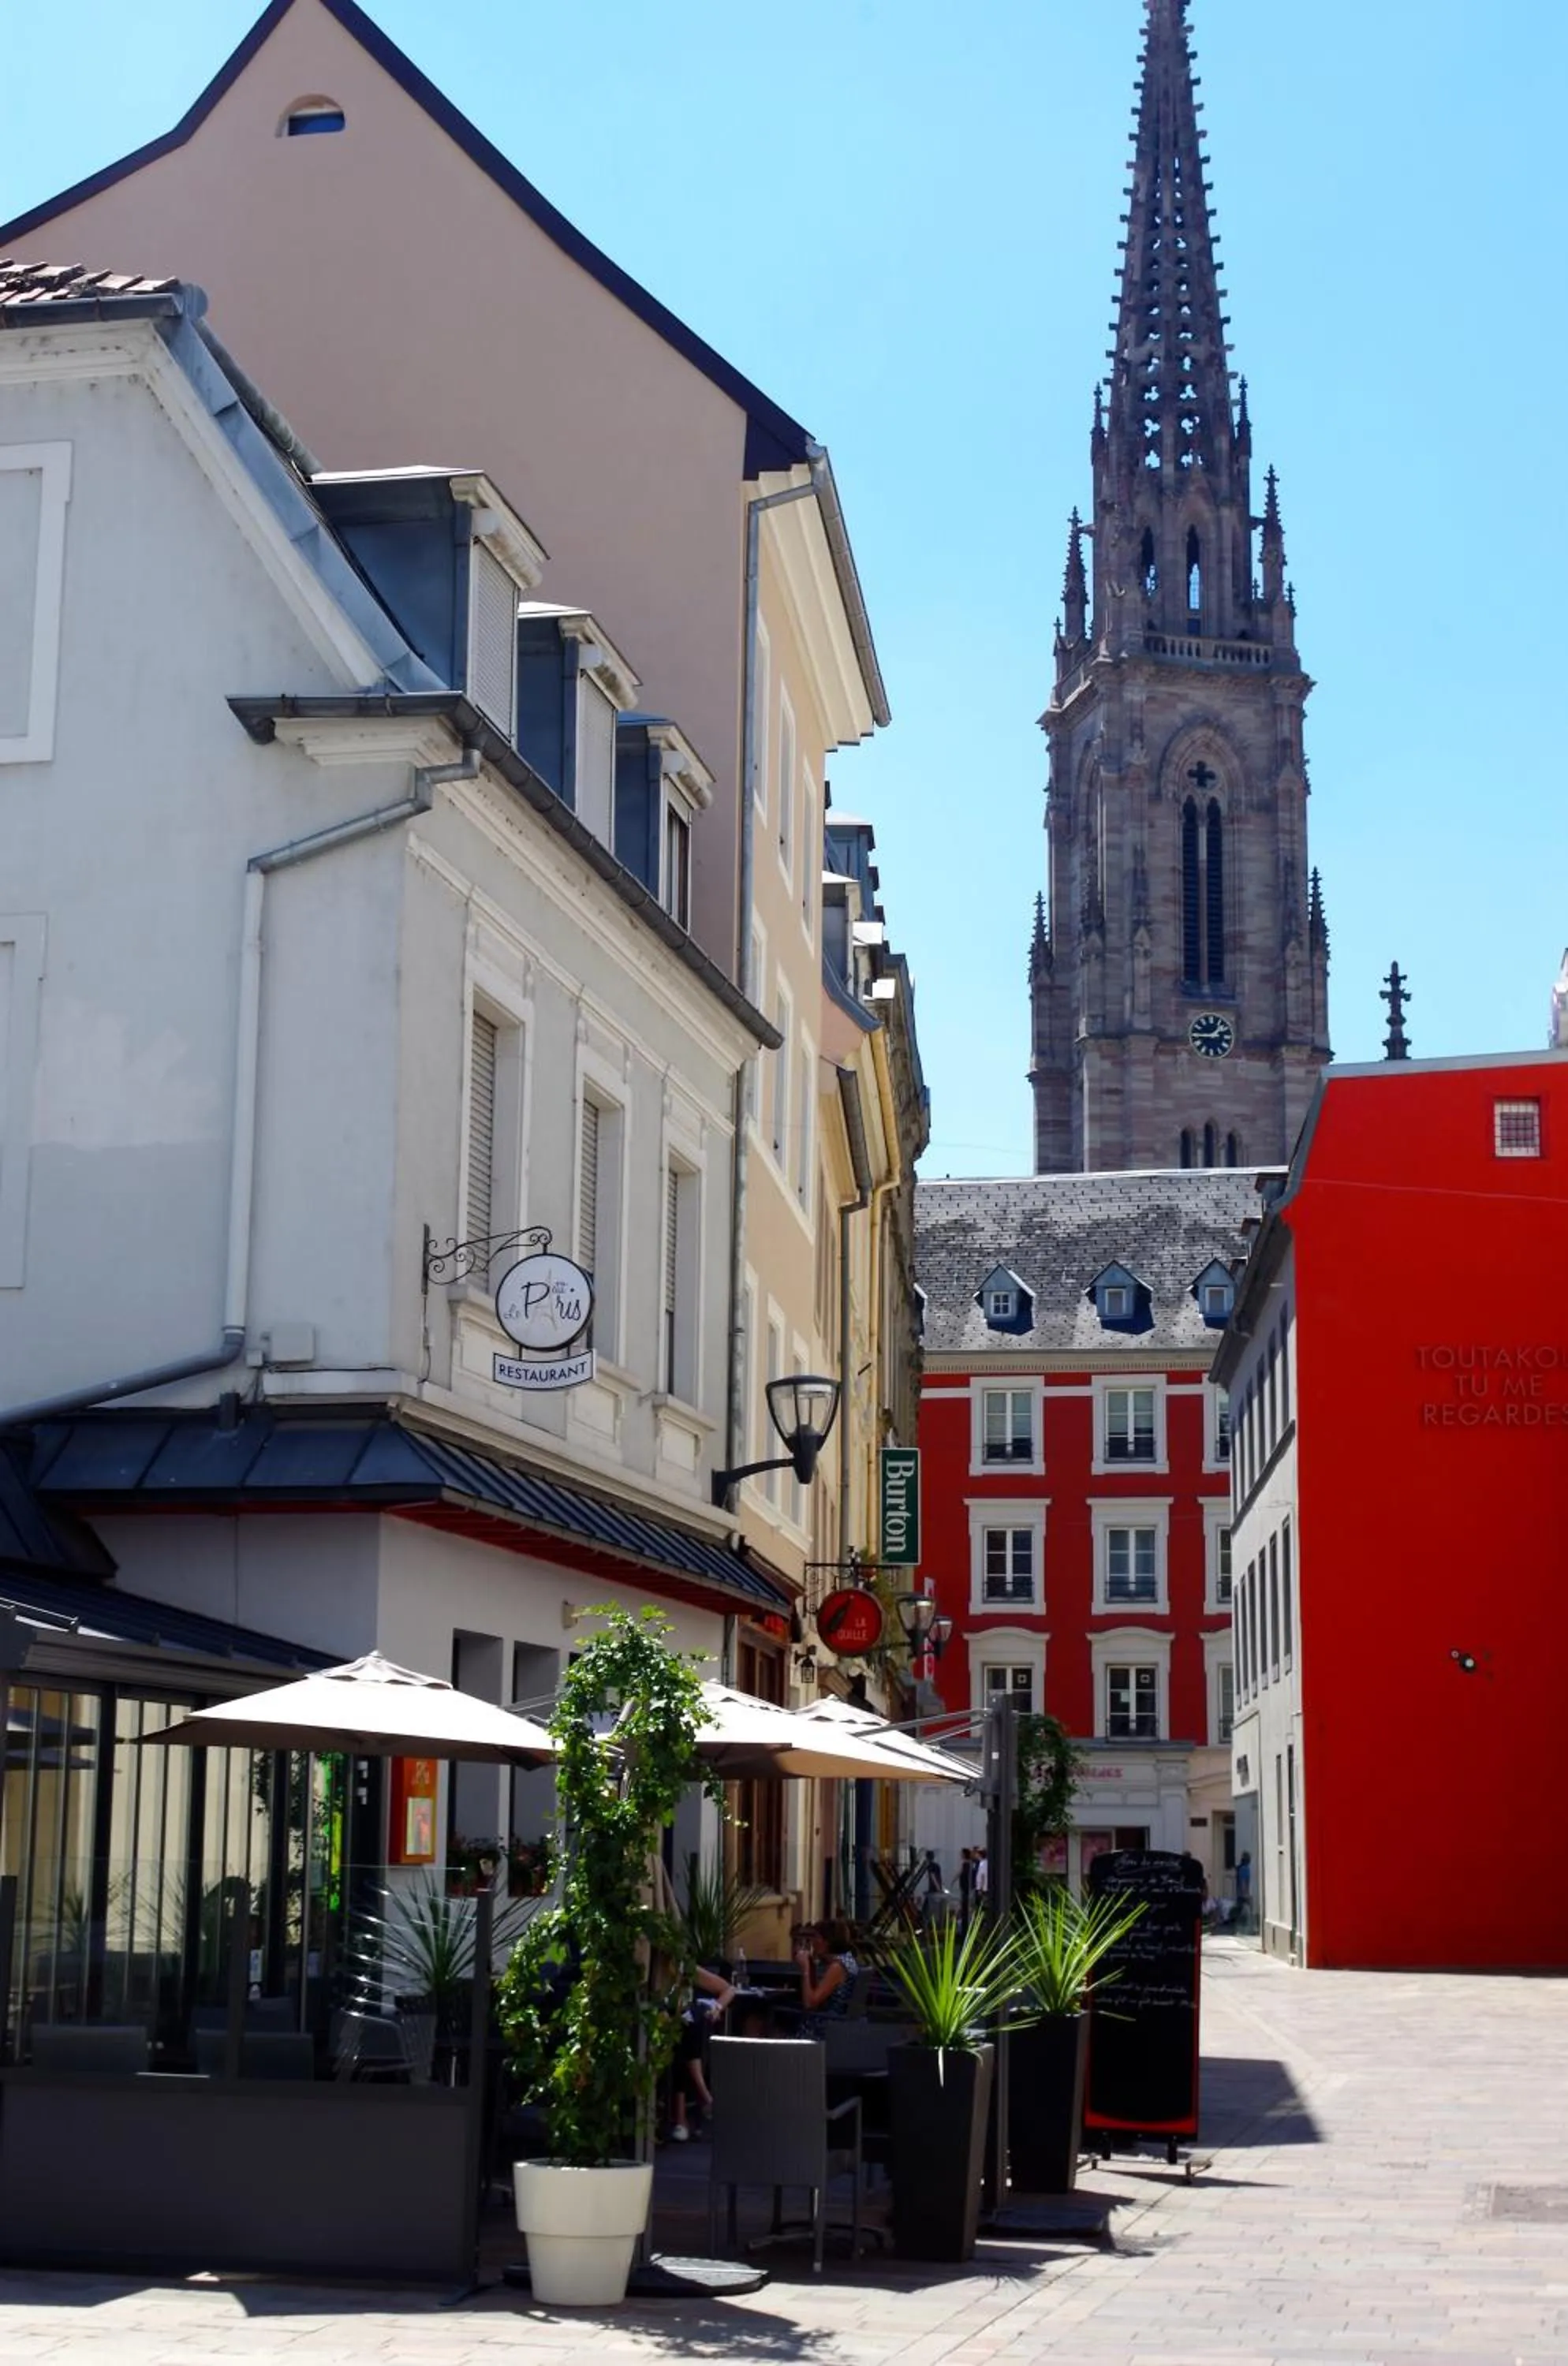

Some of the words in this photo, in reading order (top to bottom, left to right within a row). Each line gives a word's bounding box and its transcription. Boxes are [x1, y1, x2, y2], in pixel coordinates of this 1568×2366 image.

[498, 1360, 588, 1383] RESTAURANT
[1454, 1373, 1489, 1398] TU
[1502, 1373, 1544, 1398] ME
[885, 1458, 915, 1553] Burton
[855, 1618, 867, 1628] LA
